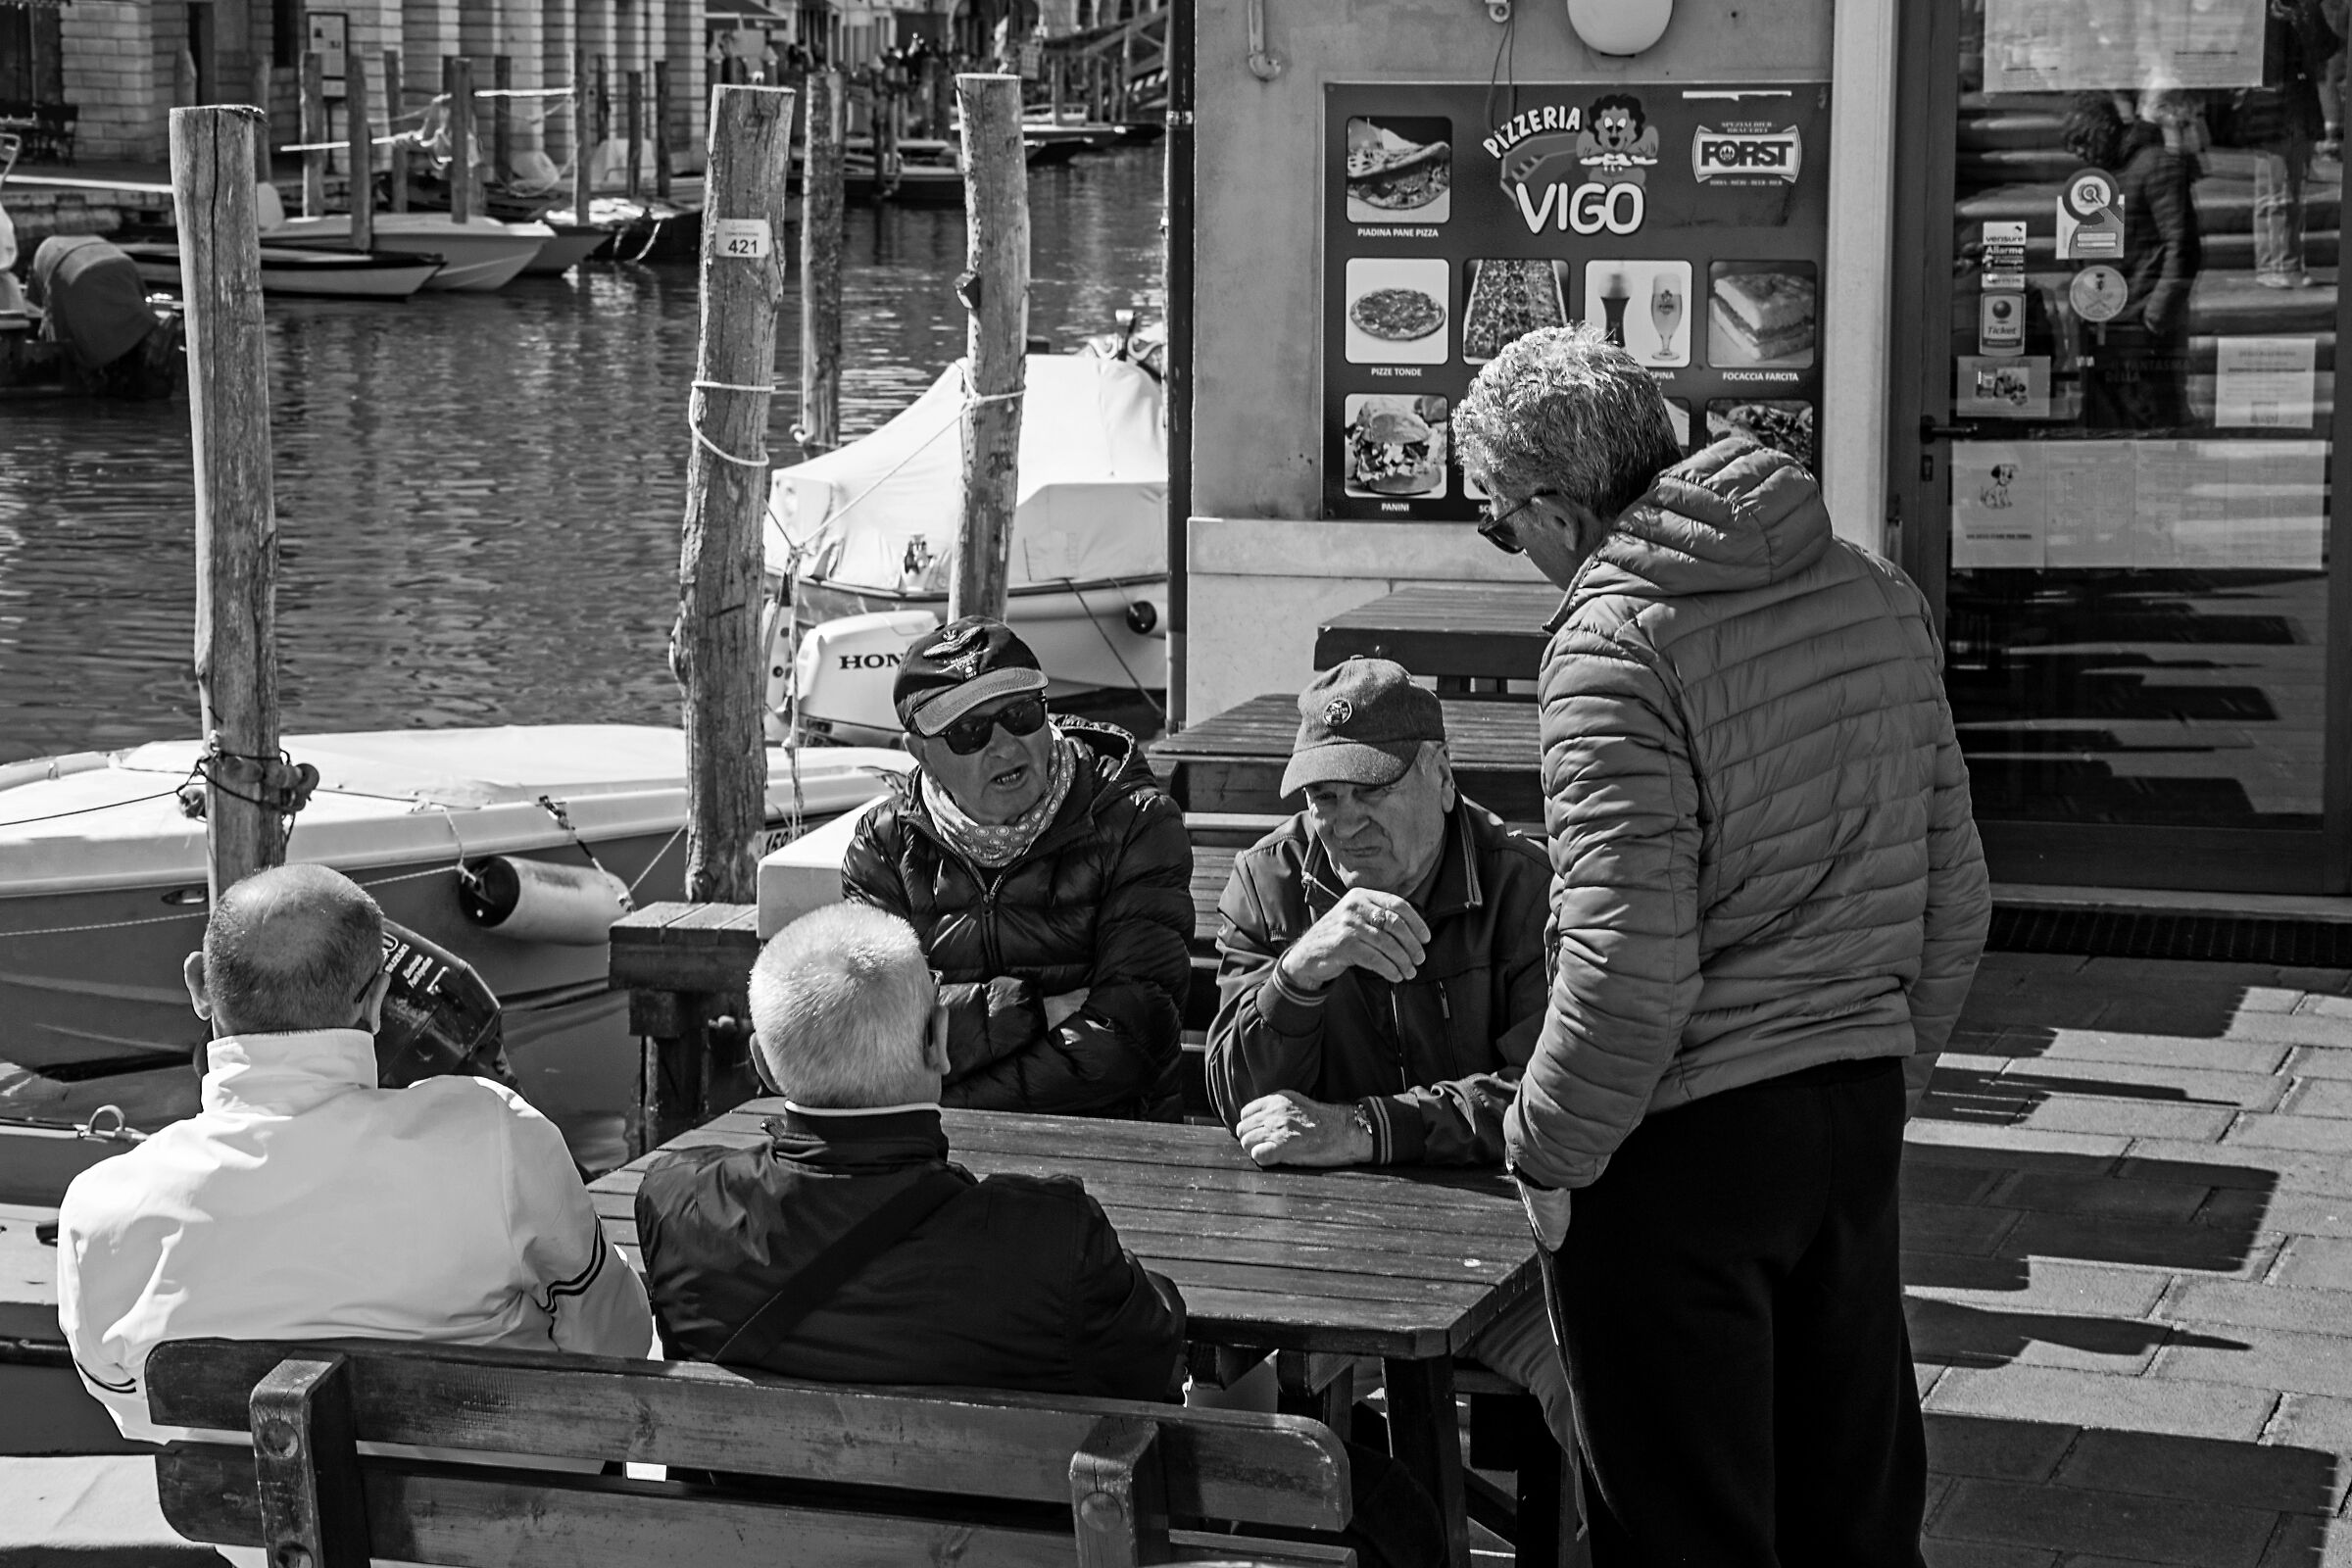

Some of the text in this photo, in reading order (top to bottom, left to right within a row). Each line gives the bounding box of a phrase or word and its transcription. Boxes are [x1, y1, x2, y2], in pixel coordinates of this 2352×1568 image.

[1482, 105, 1581, 159] PIZZERIA
[1701, 140, 1793, 167] FORST
[1515, 182, 1644, 234] VIGO
[1357, 227, 1439, 237] PIADINA PANE PIZZA
[728, 239, 758, 254] 421
[1985, 245, 2024, 255] Allarme
[1988, 325, 2017, 335] Ticket
[1371, 368, 1422, 376] PIZZE TONDE
[1723, 371, 1799, 382] FOCACCIA FARCITA
[1381, 502, 1410, 512] PANINI
[839, 654, 904, 670] HON
[385, 944, 410, 973] SUZUKI
